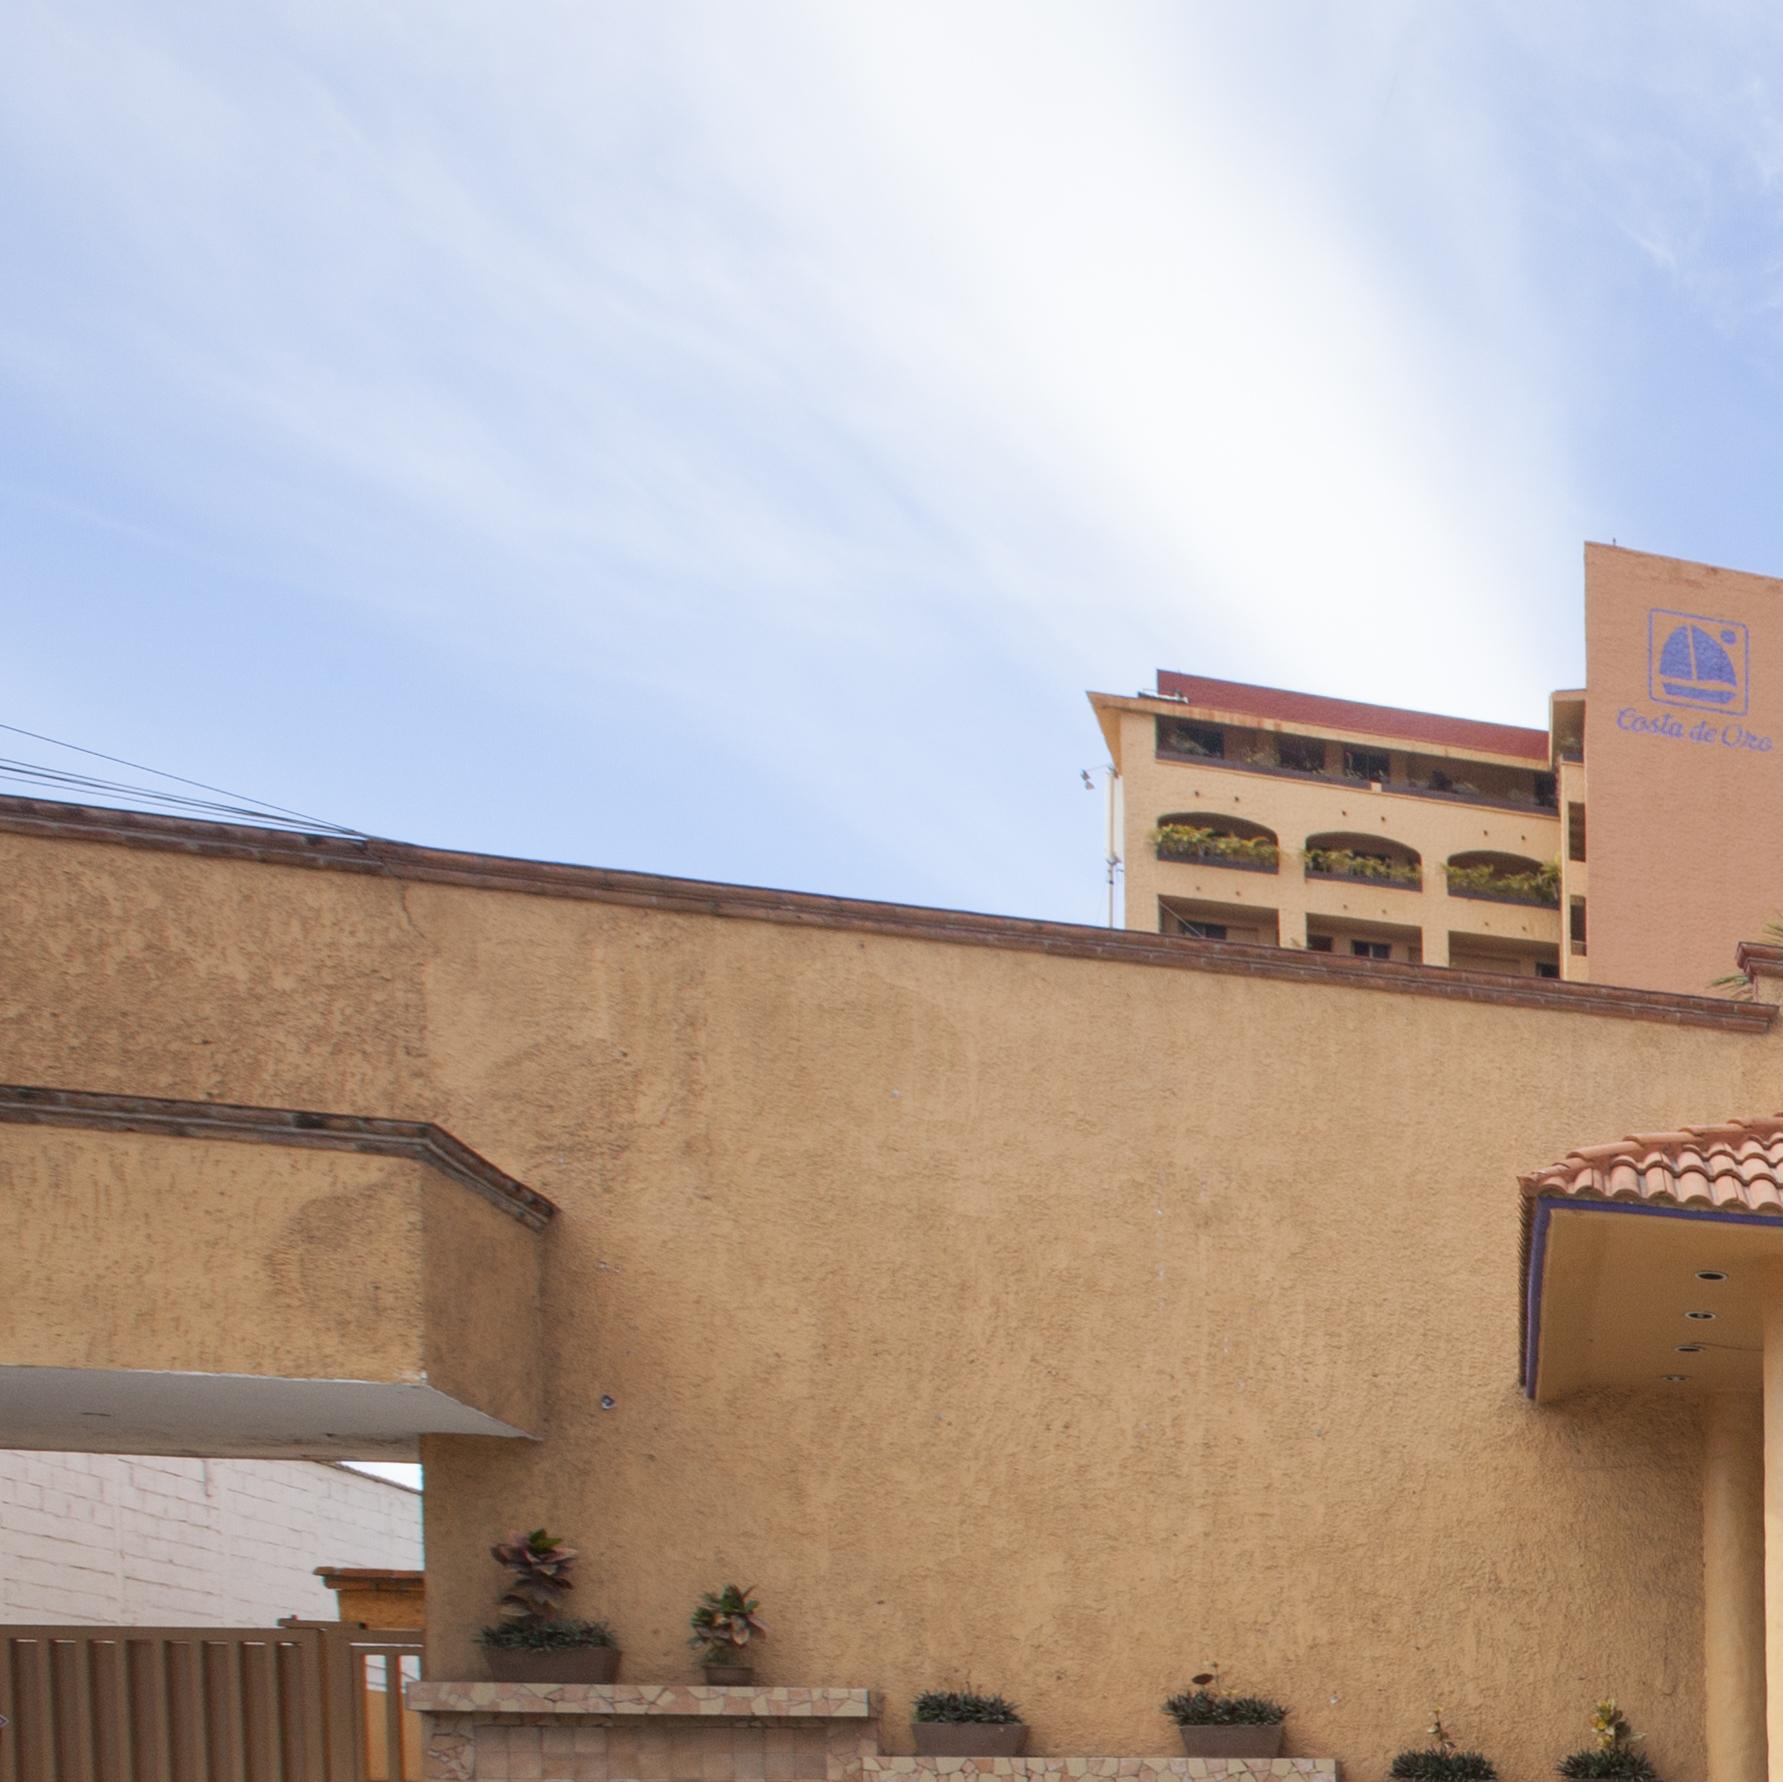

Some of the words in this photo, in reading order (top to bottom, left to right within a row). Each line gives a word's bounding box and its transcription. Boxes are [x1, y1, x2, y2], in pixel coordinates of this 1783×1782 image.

[1616, 707, 1684, 738] Costa
[1689, 720, 1718, 743] de
[1721, 723, 1773, 752] Oro
